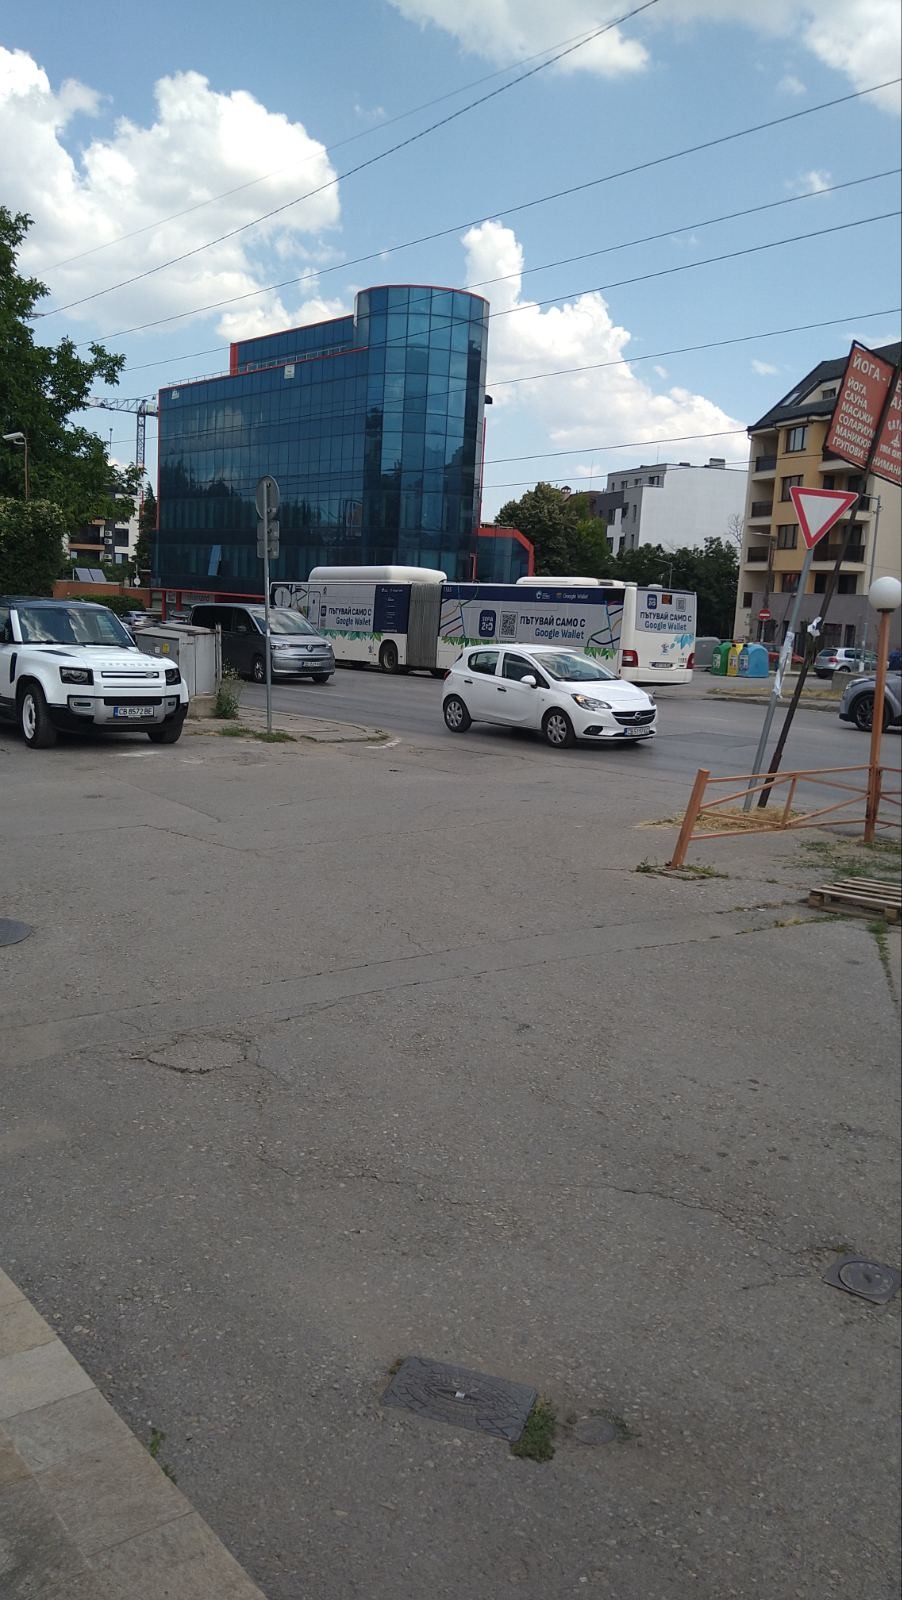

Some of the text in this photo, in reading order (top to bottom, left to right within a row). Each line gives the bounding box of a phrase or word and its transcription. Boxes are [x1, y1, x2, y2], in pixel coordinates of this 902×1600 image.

[852, 352, 880, 381] ЙОГА
[847, 377, 867, 395] ЙОГА
[844, 390, 868, 410] САУНА
[841, 401, 873, 425] МАСАЖИ
[838, 413, 875, 439] СОЛАРИУМ
[835, 424, 872, 449] МАНИКЮР
[832, 436, 864, 460] ГРУПОВИ
[328, 606, 352, 616] ПЪТУВАЙ
[352, 608, 367, 616] САМО
[367, 608, 372, 616] С
[640, 611, 669, 620] ПЪТУВАЙ
[669, 613, 688, 622] САМО
[335, 616, 371, 627] Google Wallet
[520, 615, 586, 628] ПЪТУВАЙ САМО С
[644, 620, 687, 631] Google Wallet
[535, 628, 585, 640] Google Wallet
